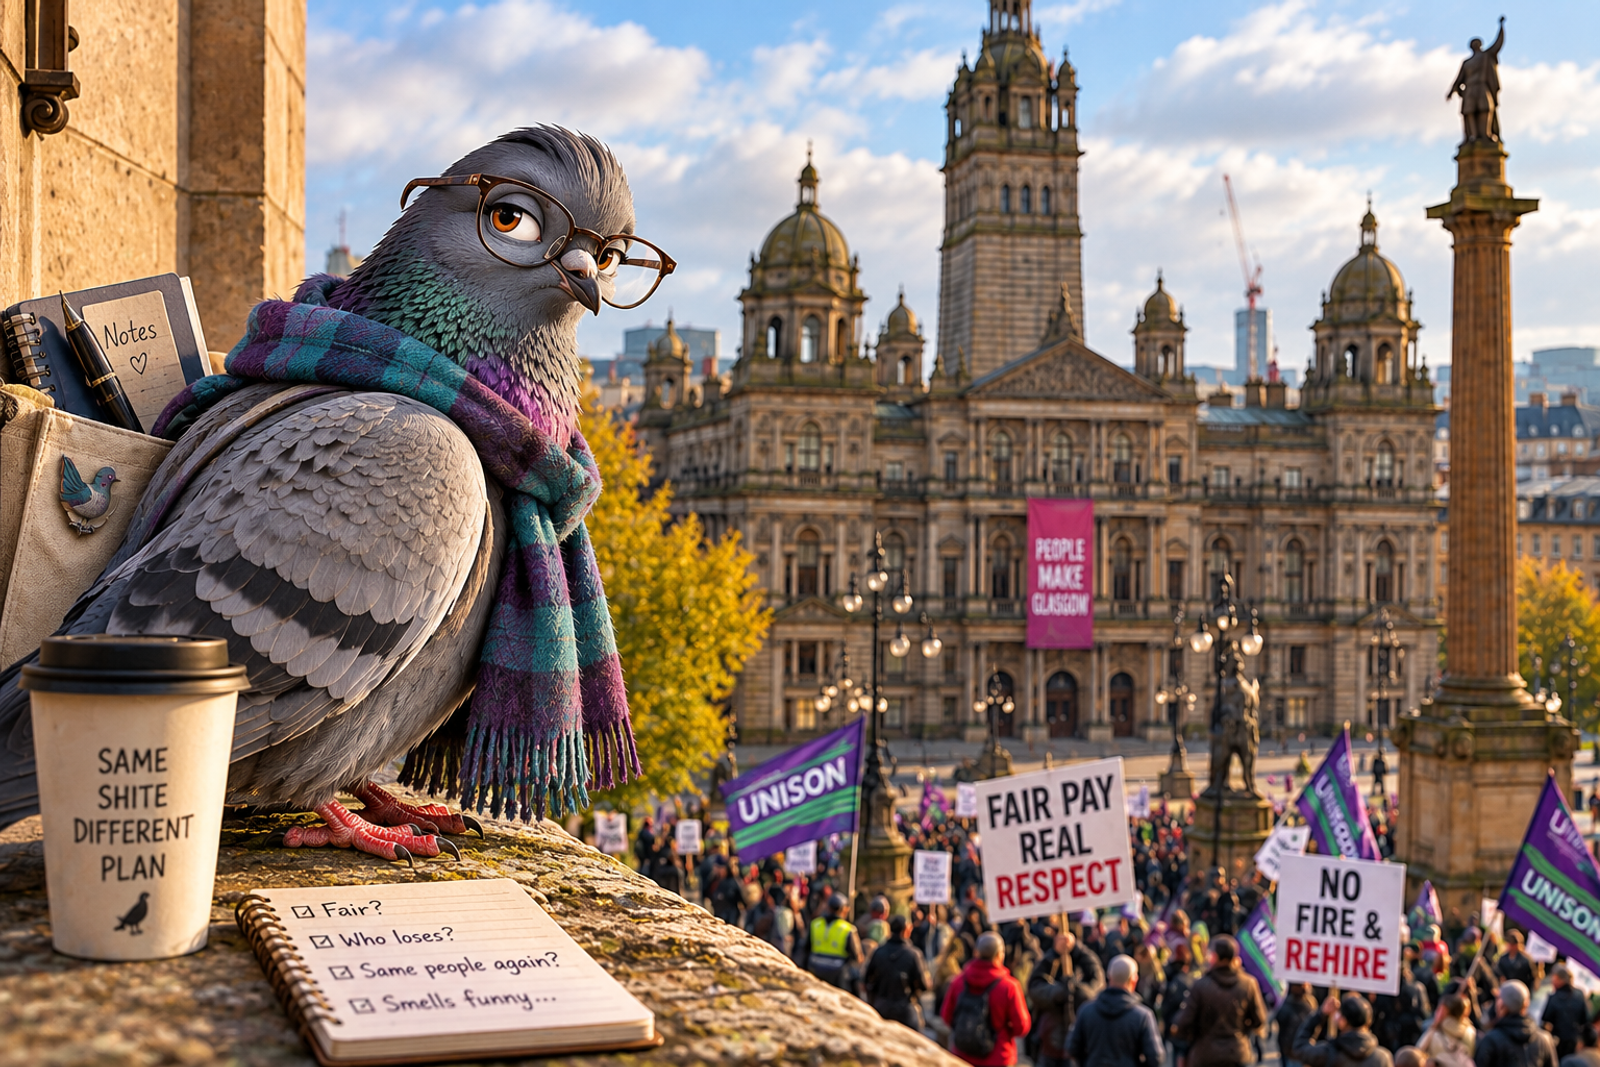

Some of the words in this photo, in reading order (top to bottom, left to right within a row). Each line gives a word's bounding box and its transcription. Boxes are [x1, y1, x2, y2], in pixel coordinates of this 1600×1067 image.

[104, 320, 157, 349] Notes
[1035, 537, 1086, 562] PEOPLE
[1037, 564, 1084, 590] MAKE
[1031, 592, 1090, 617] GLASGOW
[98, 747, 168, 774] SAME
[97, 783, 168, 810] SHITE
[737, 756, 847, 824] UNISON
[986, 786, 1052, 829] FAIR
[1061, 773, 1113, 816] PAY
[74, 814, 194, 845] DIFFERENT
[1020, 822, 1092, 865] REAL
[101, 853, 166, 882] PLAN
[996, 857, 1122, 910] RESPECT
[1319, 867, 1361, 901] NO
[321, 900, 382, 919] Fair?
[1296, 903, 1355, 938] FIRE
[1364, 911, 1382, 941] &
[338, 932, 386, 948] Who
[392, 926, 454, 946] loses?
[360, 962, 418, 980] Same
[425, 956, 487, 980] people
[494, 951, 560, 976] again?
[1284, 938, 1389, 981] REHIRE
[382, 994, 456, 1013] Smells
[465, 987, 557, 1011] funny...
